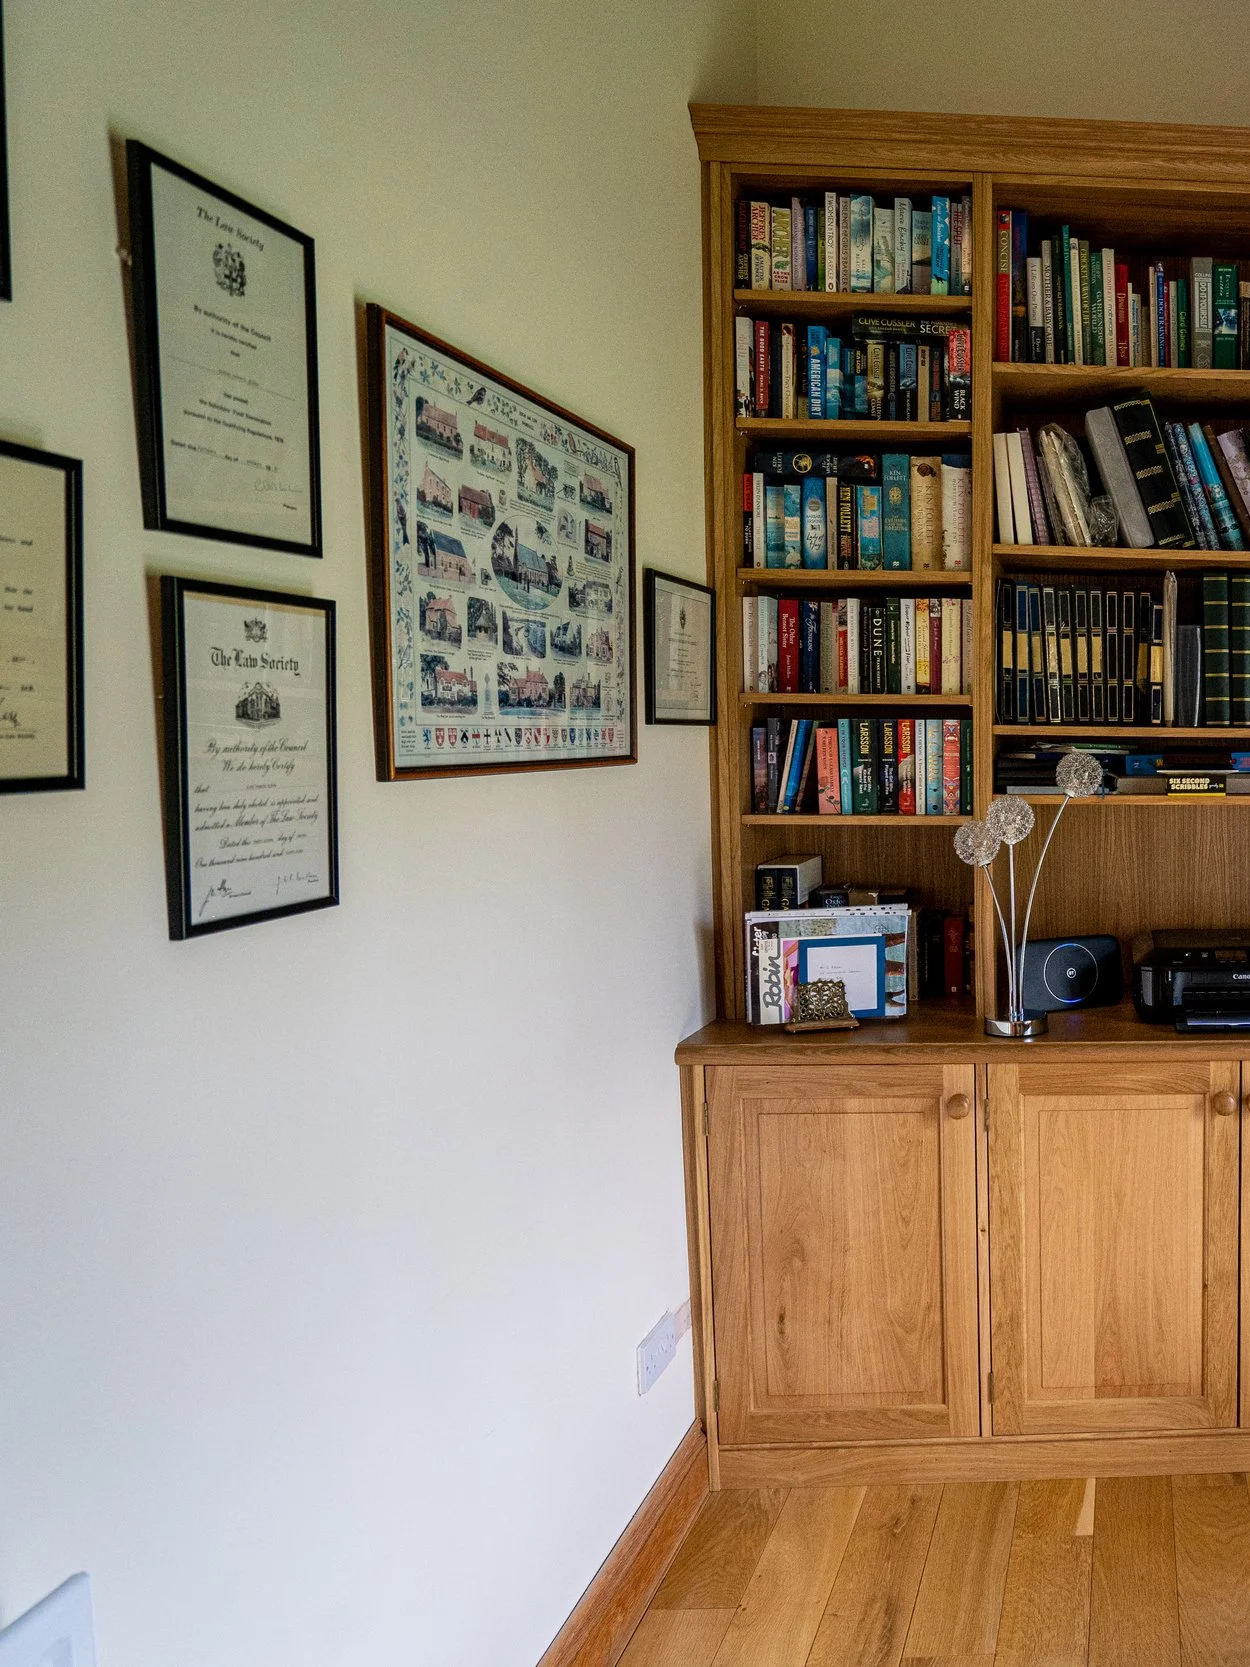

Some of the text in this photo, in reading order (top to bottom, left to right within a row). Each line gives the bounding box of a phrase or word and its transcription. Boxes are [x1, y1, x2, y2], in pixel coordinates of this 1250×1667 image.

[759, 205, 767, 242] JEFFREY
[899, 202, 907, 224] Maeve
[953, 210, 962, 245] THE SPLIT
[197, 206, 264, 252] The Law Society
[773, 209, 790, 259] ARCHER
[897, 226, 907, 252] Binchy
[1000, 231, 1010, 273] CONCISE
[859, 317, 915, 328] CLIVE CUSSLER
[1096, 291, 1104, 344] GARDENERS'
[873, 348, 881, 379] CLIVE CUSSLER
[905, 348, 913, 379] CLIVE CUSSLER
[956, 334, 965, 371] CLIVE CUSSLER
[810, 358, 821, 417] AMERICAN DIRT
[840, 487, 852, 533] KEN FOLLETT
[925, 485, 933, 545] KEN FOLLETT
[957, 478, 965, 545] KEN FOLLETT
[807, 532, 819, 541] Lady
[810, 540, 821, 551] Hay
[873, 618, 883, 656] DUNE
[211, 646, 300, 677] The Law Society
[206, 740, 219, 756] By
[222, 741, 258, 756] authority
[278, 737, 309, 752] Council
[859, 722, 869, 754] LARSSON
[884, 722, 893, 754] LARSSON
[901, 722, 911, 753] LARSSON
[222, 757, 296, 777] We do hereby Certify
[194, 784, 210, 794] that
[194, 803, 217, 817] having
[219, 836, 240, 850] Dated
[208, 856, 235, 868] thousand
[249, 851, 271, 861] hundred
[762, 955, 782, 1009] Robin
